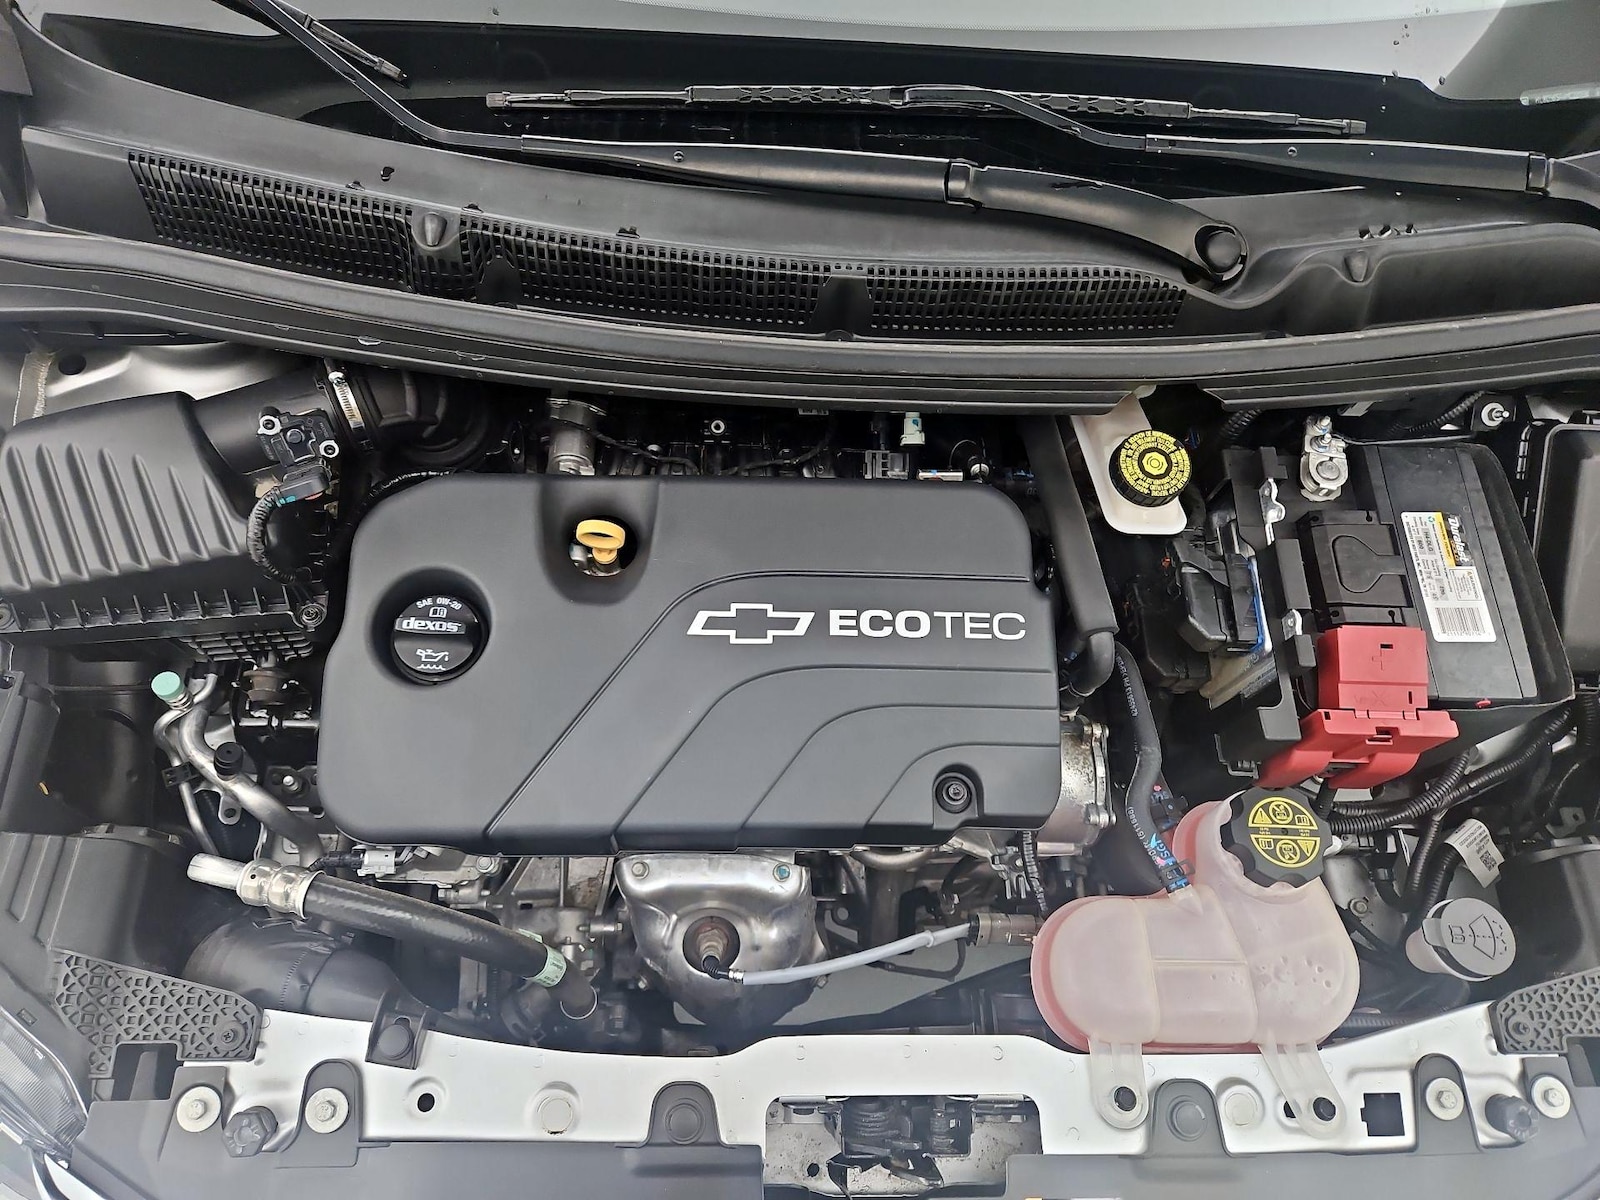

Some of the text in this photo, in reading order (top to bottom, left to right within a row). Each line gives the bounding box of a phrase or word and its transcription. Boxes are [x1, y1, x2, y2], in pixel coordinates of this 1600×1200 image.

[1447, 516, 1470, 563] Duralast
[416, 597, 462, 610] SAE 0W-20
[402, 617, 461, 632] dexos
[829, 609, 1026, 641] ECOTEC
